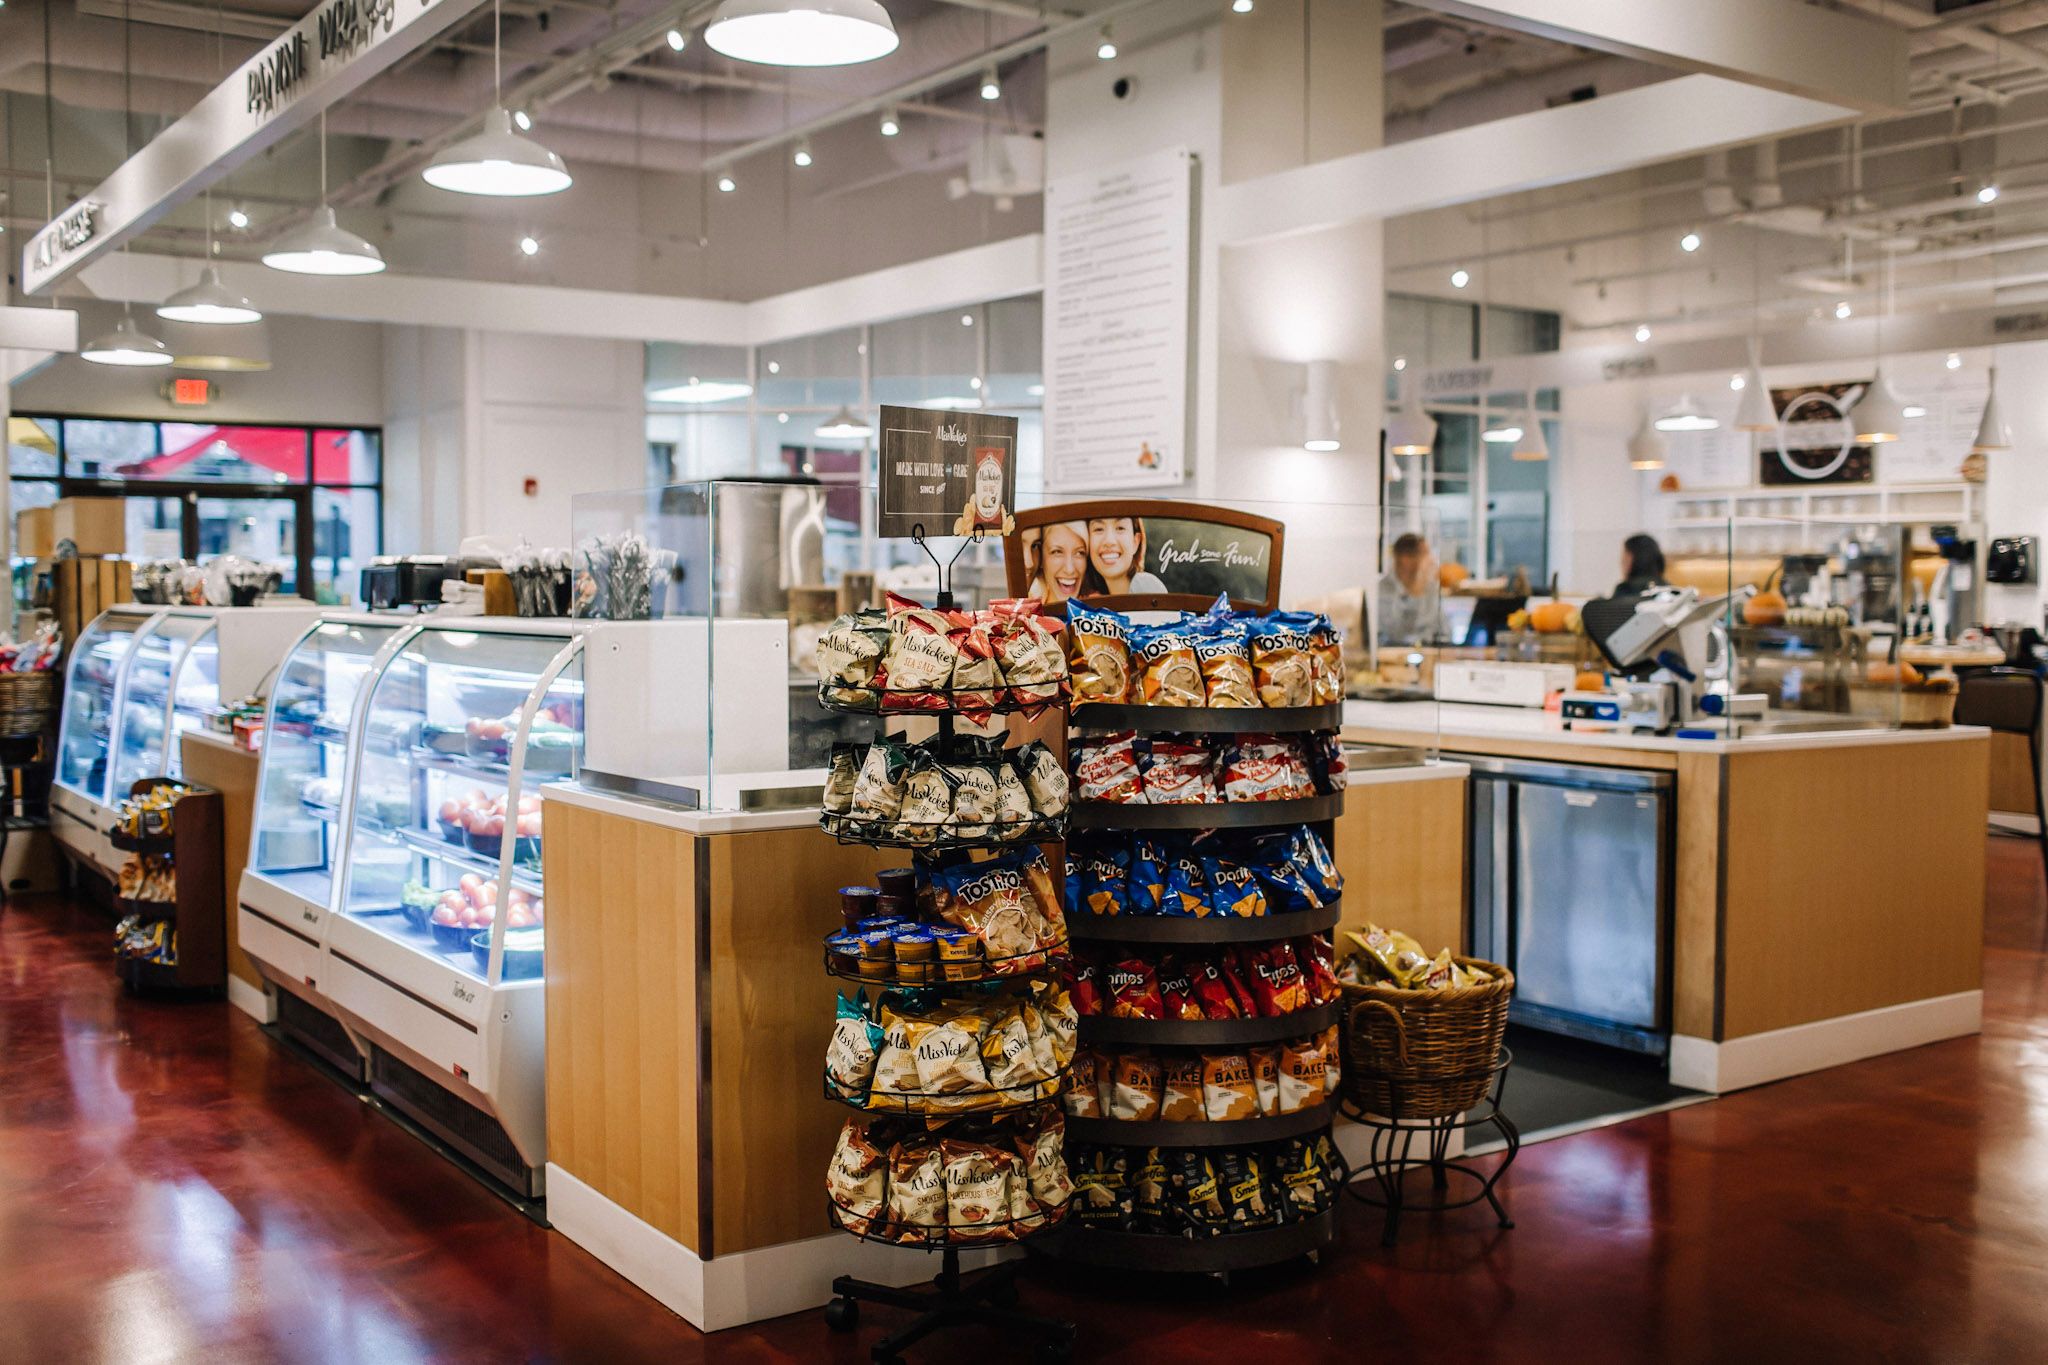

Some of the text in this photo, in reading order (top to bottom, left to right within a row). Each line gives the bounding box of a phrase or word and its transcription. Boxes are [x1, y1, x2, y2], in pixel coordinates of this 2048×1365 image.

[896, 461, 913, 476] MADE
[914, 462, 930, 476] WITH
[930, 463, 944, 477] LOVE
[920, 485, 935, 494] SINCE
[1159, 539, 1199, 574] Grab
[1223, 541, 1264, 568] Fun!
[901, 635, 922, 653] Miss
[904, 657, 916, 669] SEA
[1088, 767, 1113, 785] Jack
[957, 870, 1020, 905] TOSTITO
[918, 1044, 943, 1061] Miss
[1215, 1068, 1249, 1084] BAKE
